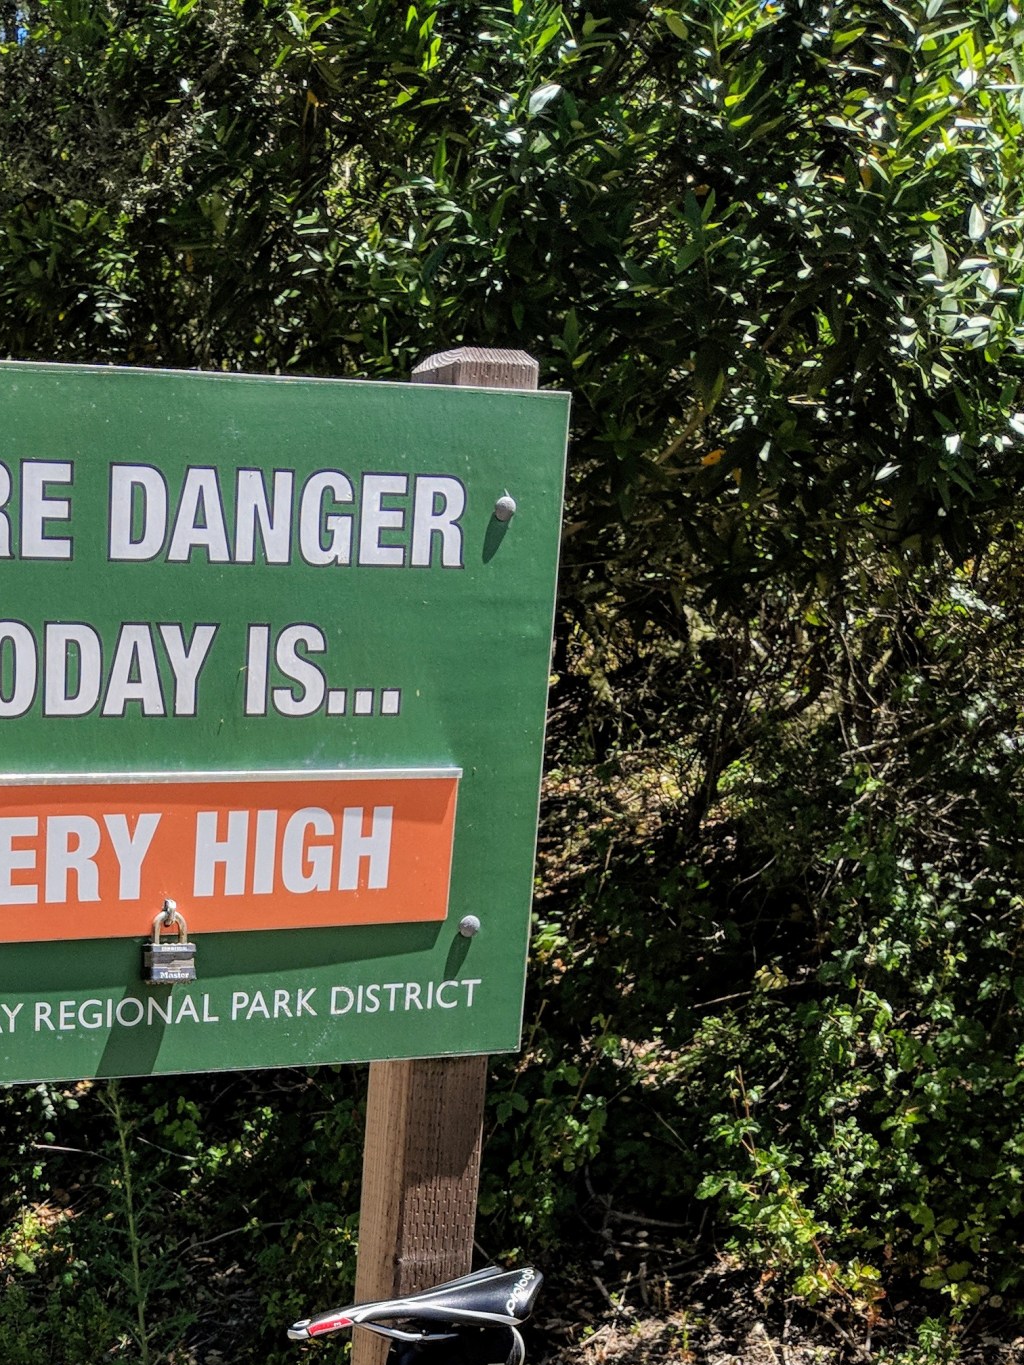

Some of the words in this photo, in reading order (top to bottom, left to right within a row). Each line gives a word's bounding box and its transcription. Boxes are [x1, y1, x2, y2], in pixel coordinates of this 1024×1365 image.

[107, 462, 467, 569] DANGER
[244, 622, 402, 717] IS...
[194, 806, 394, 898] HIGH
[34, 994, 219, 1032] REGIONAL
[231, 987, 318, 1021] PARK
[330, 979, 482, 1016] DISTRICT
[159, 971, 190, 979] Master
